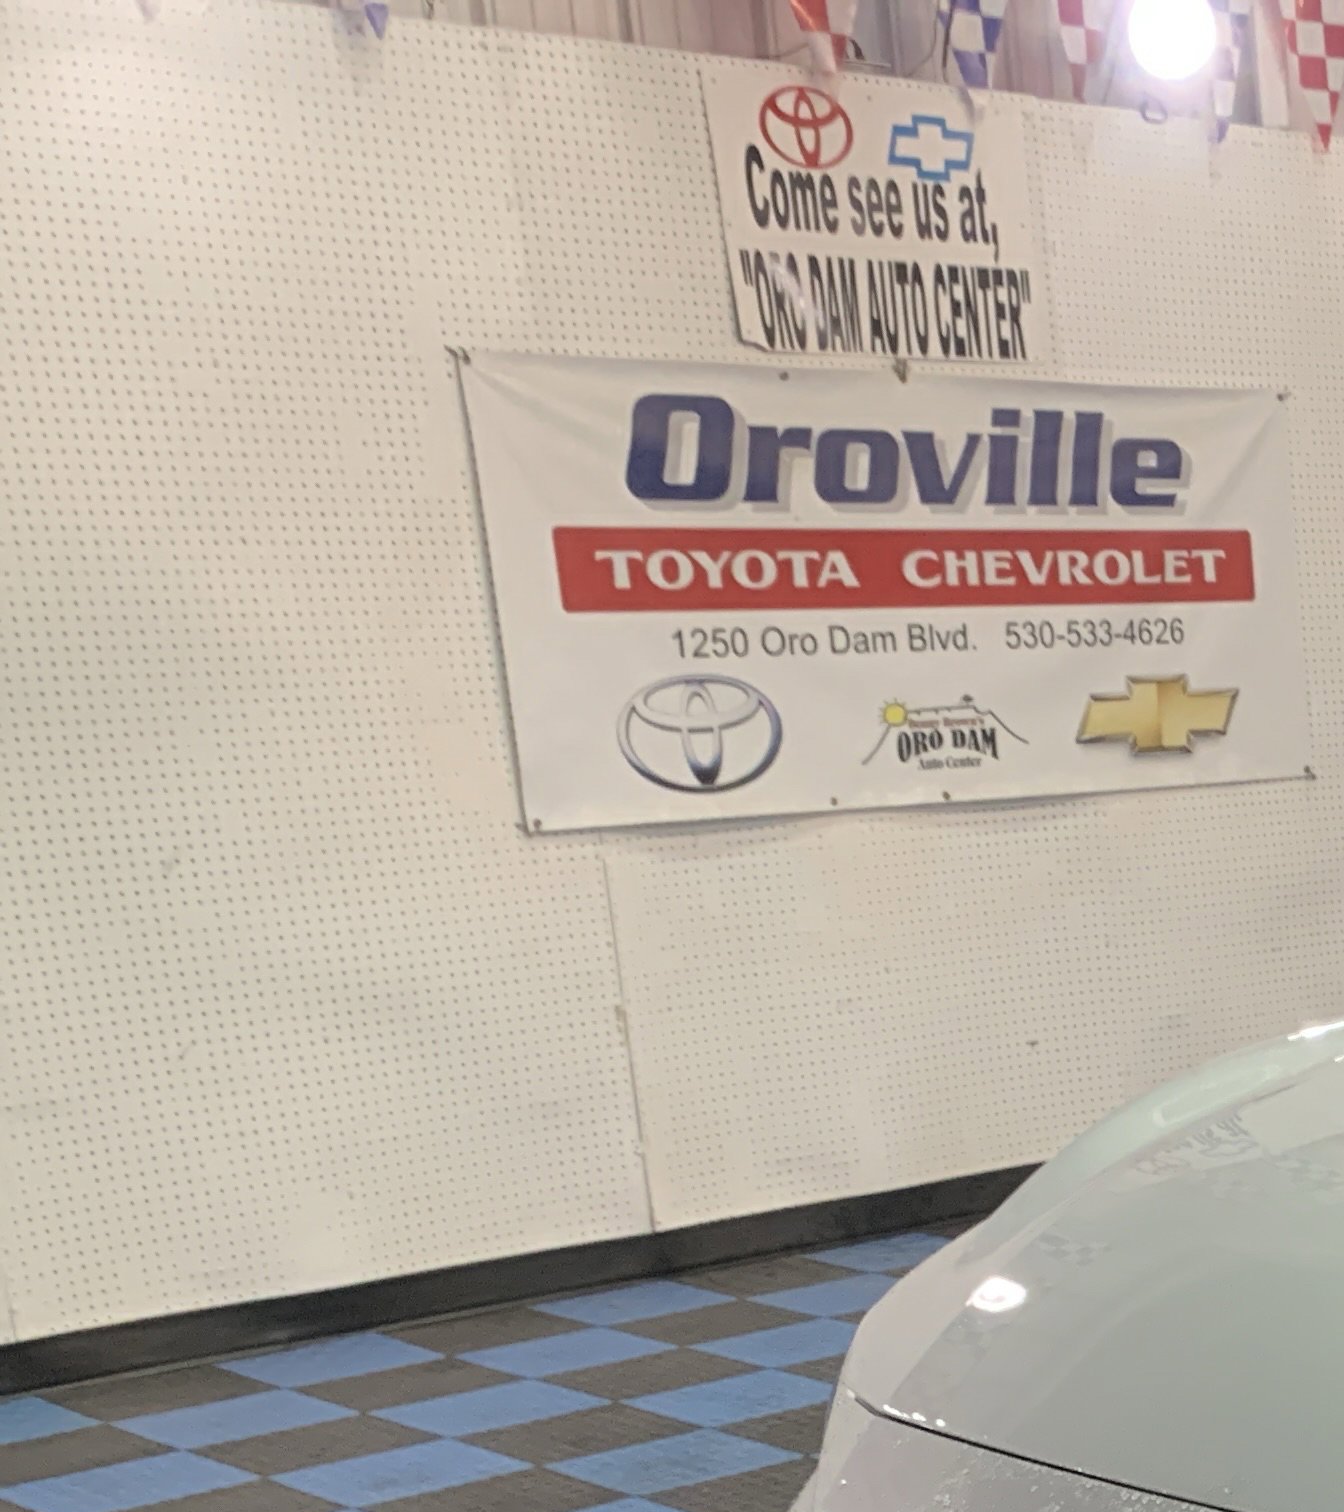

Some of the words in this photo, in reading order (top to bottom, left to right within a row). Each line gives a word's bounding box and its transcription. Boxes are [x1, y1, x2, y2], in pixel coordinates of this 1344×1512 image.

[745, 144, 839, 233] Come
[847, 175, 904, 239] see
[912, 182, 951, 242] us
[959, 168, 1000, 264] at,
[808, 254, 864, 353] DAM
[866, 258, 930, 358] AUTO
[933, 262, 1031, 361] CENTER"
[625, 394, 1188, 511] Oroville
[595, 548, 861, 590] TOYOTA
[902, 549, 1226, 588] CHEVROLET
[672, 626, 749, 658] 1250
[761, 626, 818, 657] Oro
[828, 625, 897, 655] Dam
[907, 622, 978, 651] Blvd.
[1005, 617, 1185, 650] 530-533-4626
[897, 728, 944, 763] ORO
[950, 727, 999, 760] DAM
